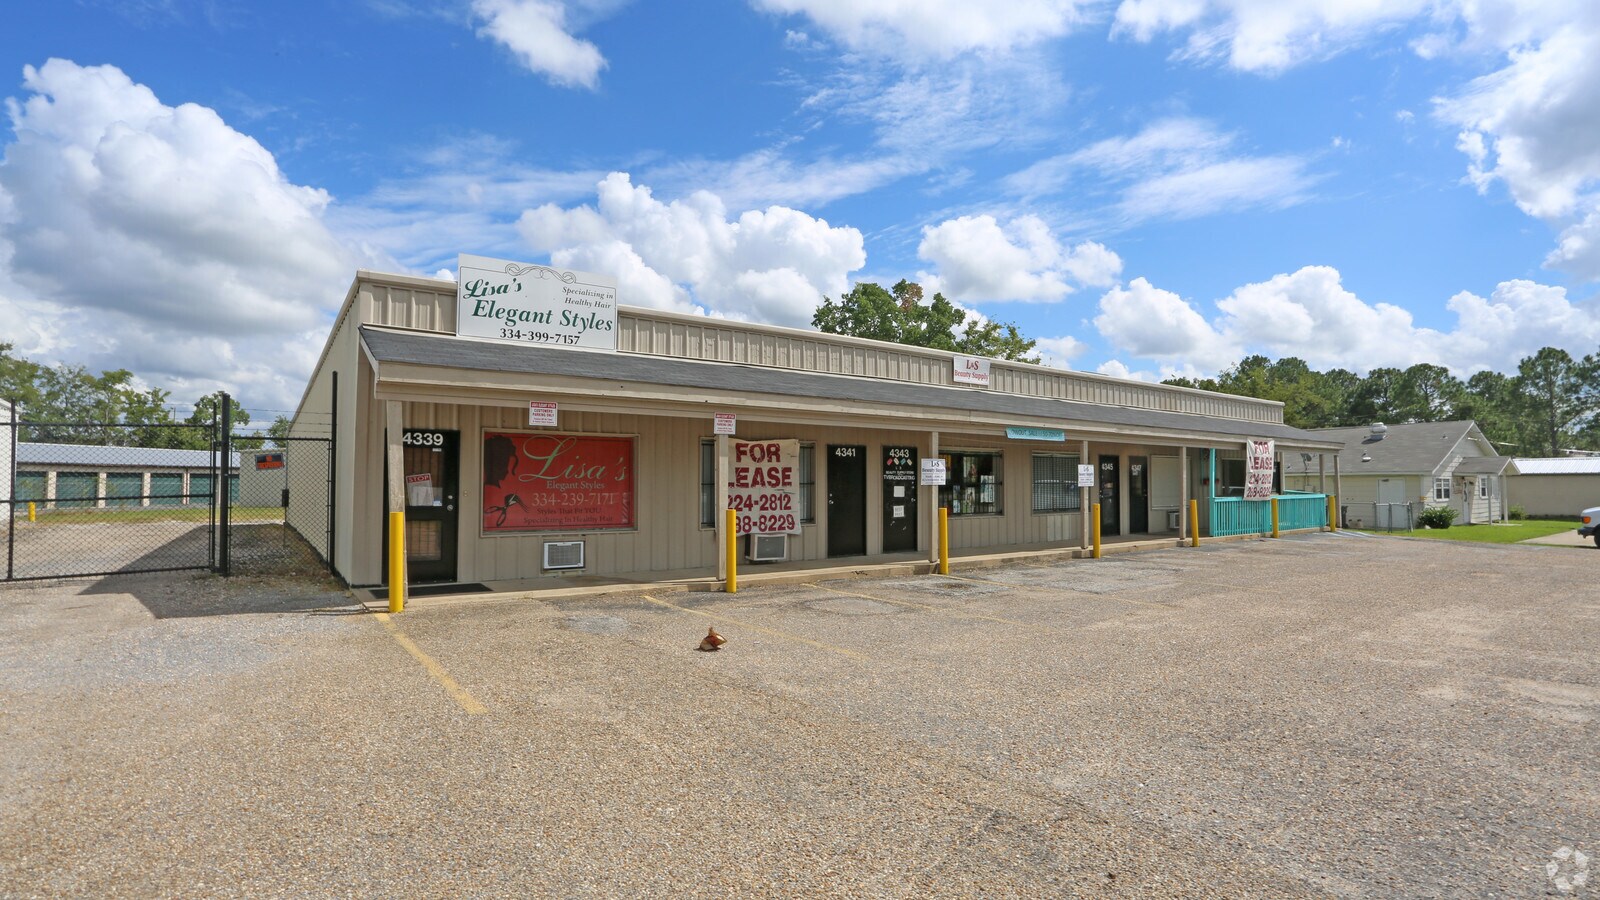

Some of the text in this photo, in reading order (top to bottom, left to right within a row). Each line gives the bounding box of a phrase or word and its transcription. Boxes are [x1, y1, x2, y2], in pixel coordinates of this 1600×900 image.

[463, 278, 522, 299] Lisa's
[562, 286, 613, 299] Specializing in
[565, 297, 611, 309] Healthy Hair
[472, 299, 613, 334] Elegant Styles
[500, 328, 580, 345] 334-399-7157
[966, 360, 979, 370] L&S
[955, 370, 989, 381] Beauty Supply
[402, 432, 444, 446] 4339
[736, 442, 780, 463] FOR
[836, 448, 856, 457] 4341
[890, 448, 910, 458] 4343
[1254, 440, 1270, 454] FOR
[518, 435, 627, 482] Lisa's
[408, 474, 430, 482] STOP
[546, 480, 605, 491] Elegant Styles
[532, 492, 614, 506] 334-239-7171
[537, 508, 556, 516] Styles
[524, 516, 563, 526] Specializing
